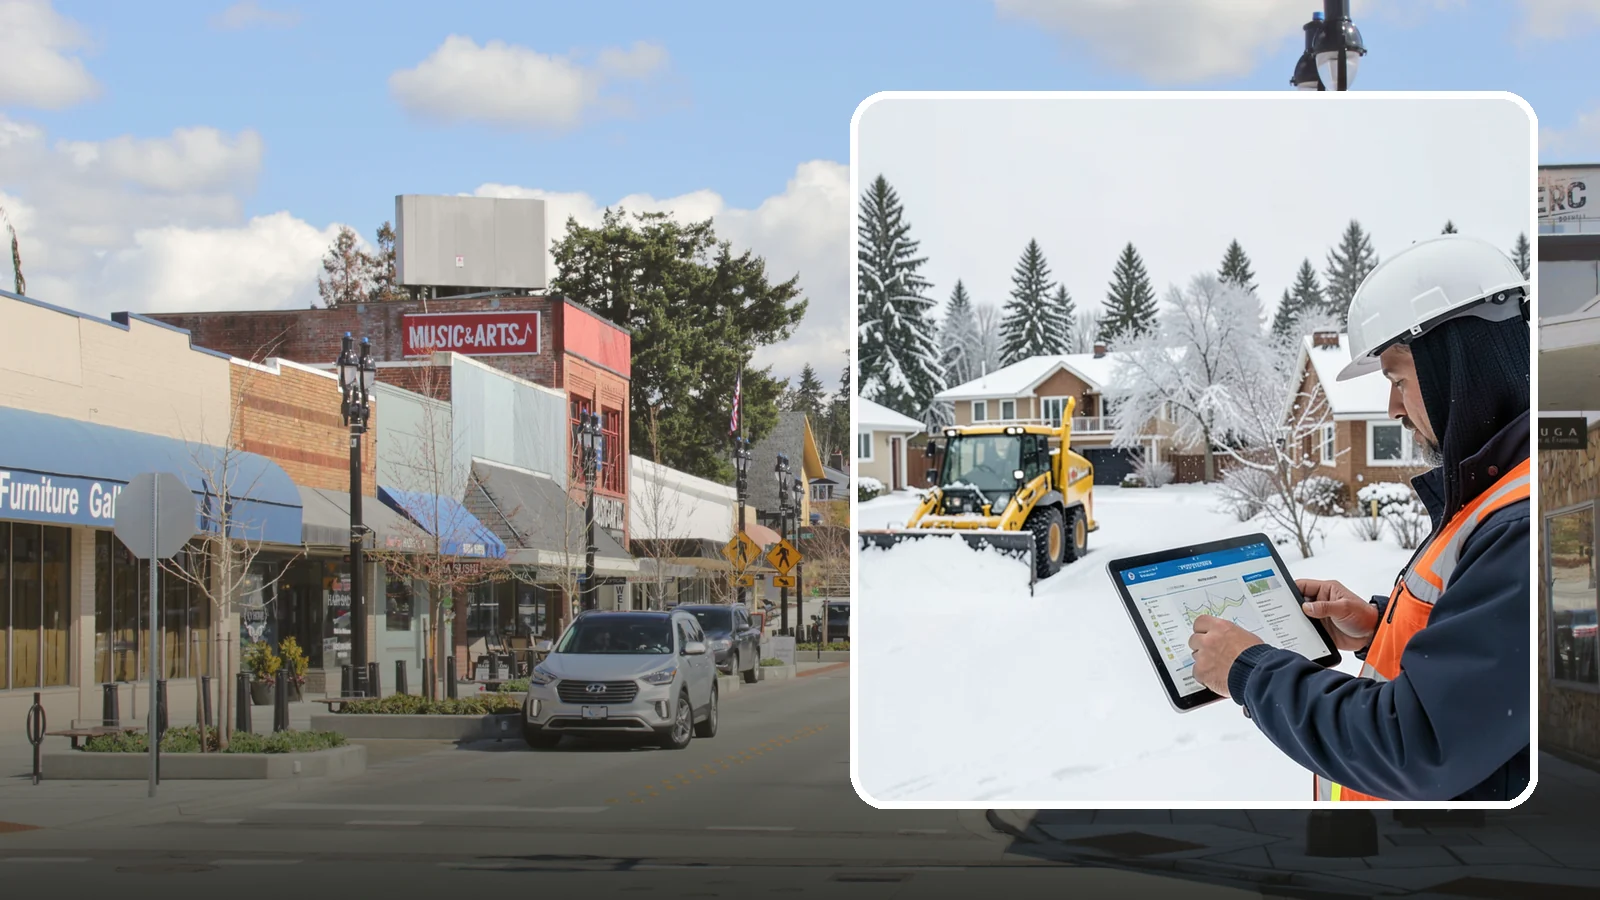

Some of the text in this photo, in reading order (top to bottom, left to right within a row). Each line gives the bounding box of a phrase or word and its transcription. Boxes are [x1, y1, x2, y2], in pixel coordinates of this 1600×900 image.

[409, 323, 519, 349] MUSIC&ARTS
[0, 472, 121, 519] Furniture Gal
[453, 563, 479, 574] SUSHI
